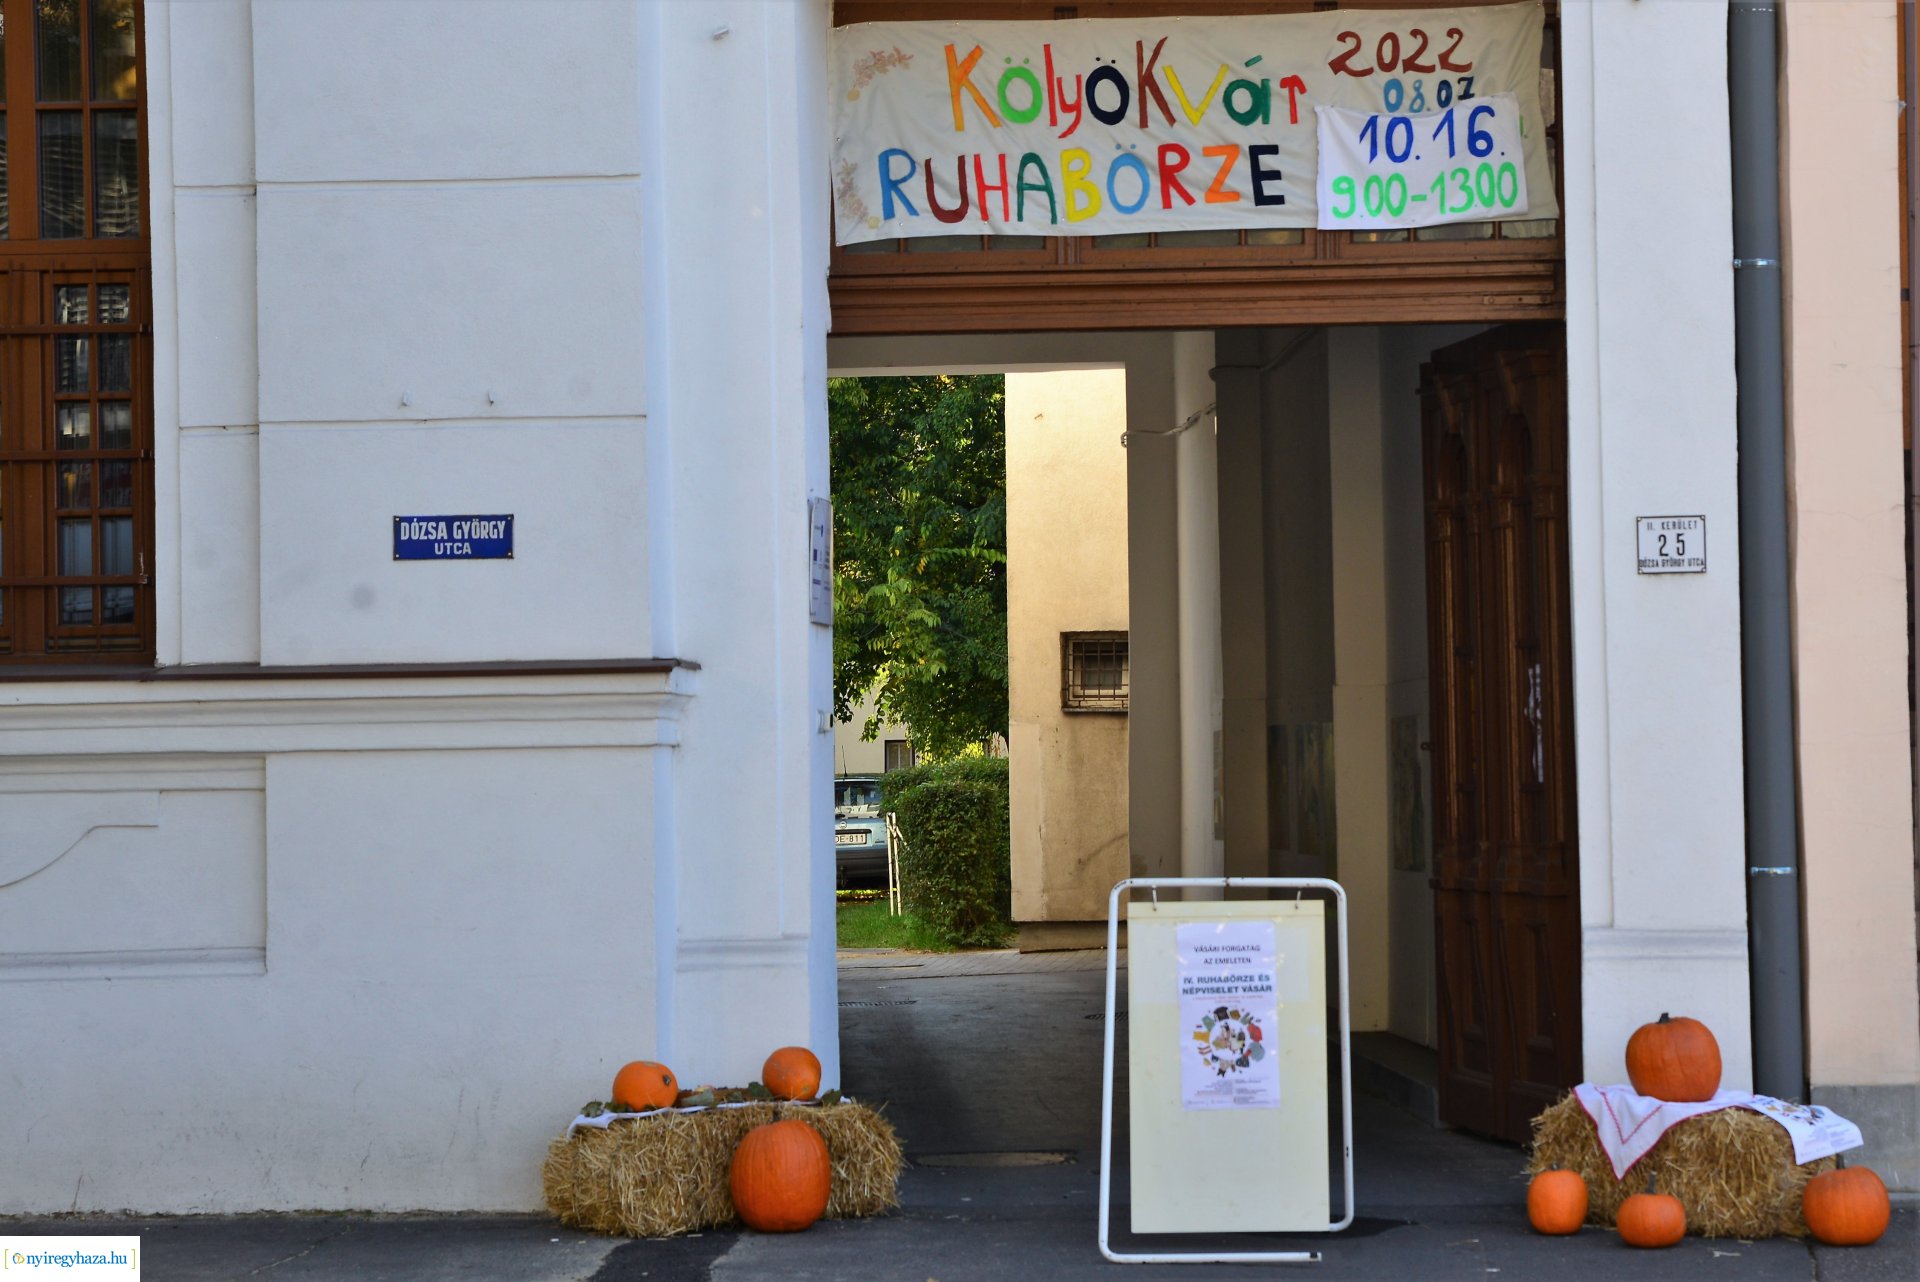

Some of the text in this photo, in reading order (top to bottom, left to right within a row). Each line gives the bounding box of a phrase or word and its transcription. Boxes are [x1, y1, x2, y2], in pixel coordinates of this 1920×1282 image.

[1328, 27, 1473, 77] 2022
[878, 143, 1285, 224] RUHABÖRZE
[400, 518, 506, 540] DÓZSA GYÖRGY
[1661, 519, 1697, 530] KERÜLET
[434, 542, 472, 555] UTCA
[1658, 533, 1685, 557] 25
[1662, 557, 1685, 567] GYÖRGY
[1688, 558, 1705, 567] UTCA
[1221, 944, 1261, 952] FORGATAG
[1214, 956, 1251, 965] EMELETEN
[1183, 973, 1270, 985] IV. RUHABÖRZE ÉS
[1182, 984, 1272, 995] NÉPVISELET VÁSÁR
